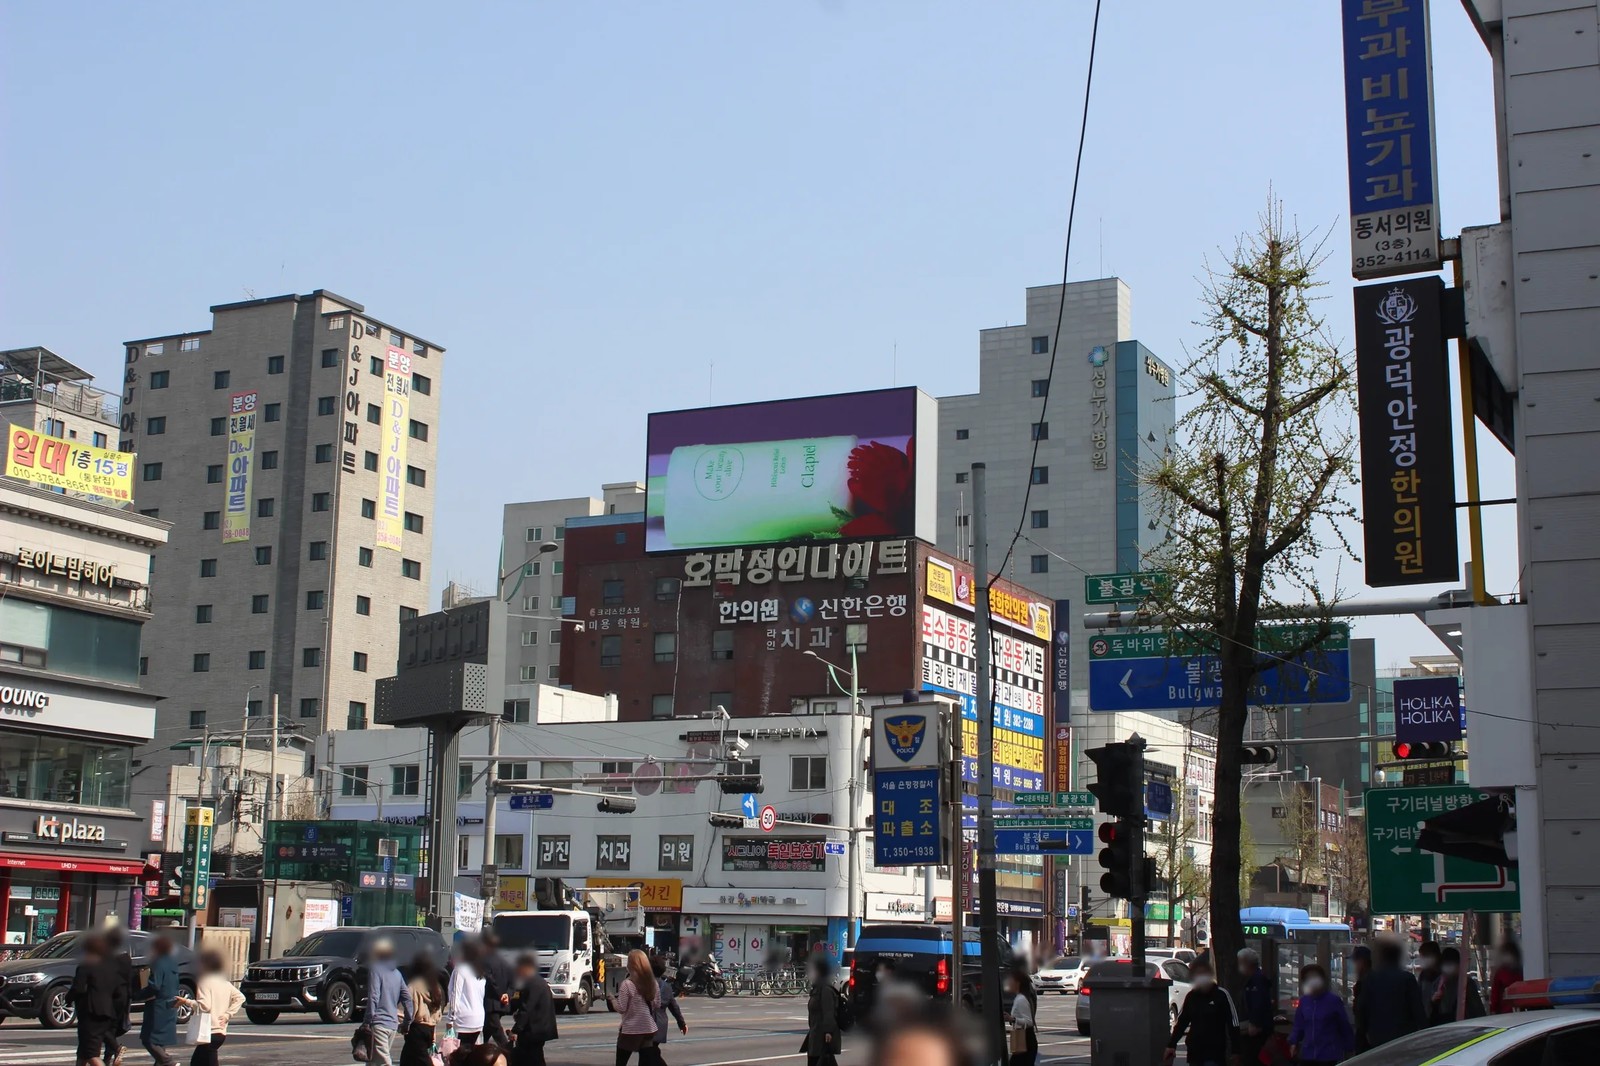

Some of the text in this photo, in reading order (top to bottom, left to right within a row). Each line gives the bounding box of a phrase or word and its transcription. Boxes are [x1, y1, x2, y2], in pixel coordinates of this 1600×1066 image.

[1355, 209, 1432, 240] 동서의원
[1375, 237, 1412, 252] (3층)
[1356, 248, 1432, 268] 352-4114
[388, 349, 411, 374] 분양
[231, 393, 257, 413] 분양
[1090, 369, 1109, 471] 성누가병원
[13, 430, 71, 477] 임대
[229, 437, 253, 454] D&J
[71, 449, 92, 470] 1층
[801, 445, 820, 488] Clapiel
[705, 460, 715, 480] Make
[228, 455, 250, 513] 아파트
[714, 474, 724, 494] your
[719, 598, 779, 624] 한의원
[818, 594, 907, 619] 신한은행
[588, 618, 611, 630] 미용
[766, 626, 832, 651] 라인 치과
[1400, 696, 1454, 711] HOLIKA
[1401, 710, 1455, 725] HOLIKA
[882, 781, 896, 790] 서울
[1061, 794, 1088, 803] 불광역
[38, 815, 105, 843] kt plaza
[764, 814, 773, 825] 50
[600, 840, 630, 863] 치과
[662, 841, 691, 862] 의원
[767, 842, 825, 860] 독일보청기
[7, 859, 26, 867] Internet
[1244, 926, 1268, 935] 708
